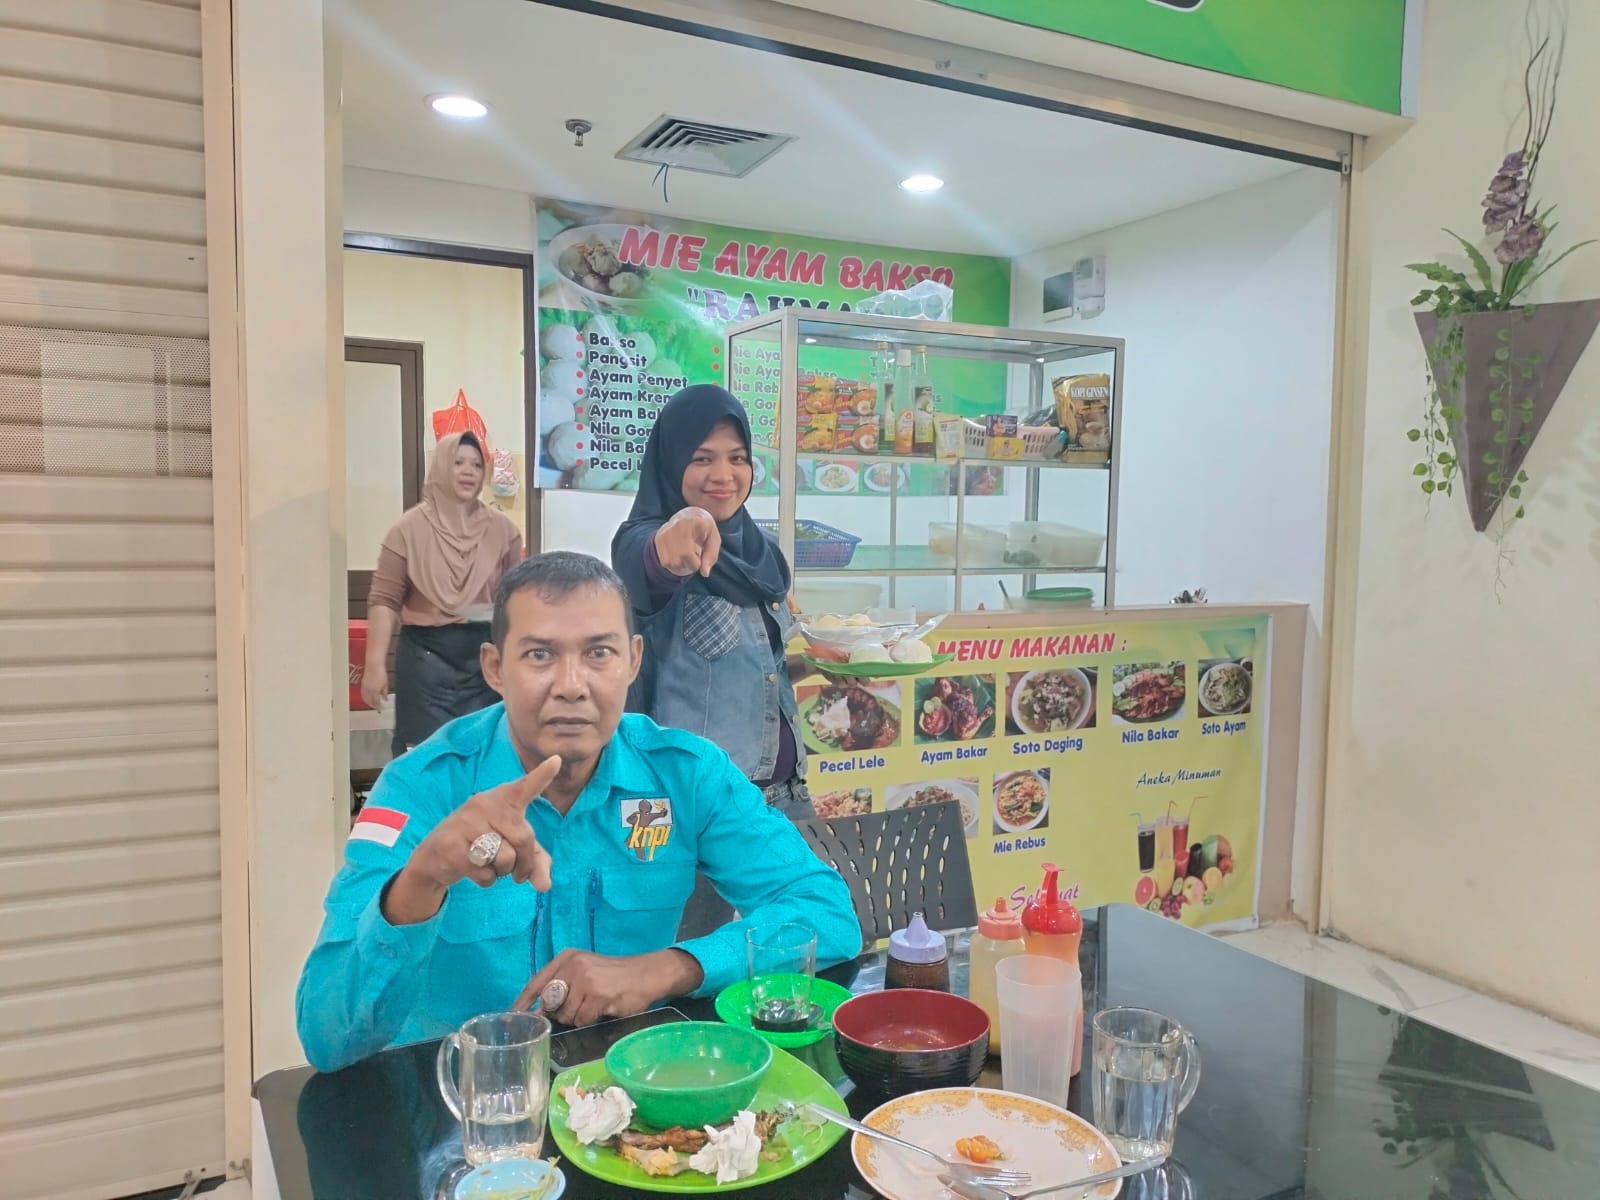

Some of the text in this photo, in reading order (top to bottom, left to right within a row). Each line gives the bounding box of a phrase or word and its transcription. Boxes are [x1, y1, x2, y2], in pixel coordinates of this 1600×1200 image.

[618, 226, 954, 292] MIE AYAM BAKSO
[589, 332, 636, 349] Baso
[589, 350, 647, 369] Pangsit
[754, 348, 781, 362] Aya
[590, 369, 688, 390] Ayam Penyet
[754, 365, 781, 379] Aya
[590, 387, 633, 403] Ayam
[754, 382, 779, 394] Reb
[590, 404, 633, 420] Ayam
[590, 422, 620, 436] Nila
[590, 440, 620, 453] Nila
[590, 457, 632, 471] Pecel
[937, 638, 1004, 662] MENU
[1009, 632, 1116, 658] MAKANAN
[1122, 727, 1179, 743] Nila Bakar
[1201, 720, 1246, 735] Soto Ayam
[1012, 736, 1083, 754] Soto Daging
[921, 746, 988, 765] Ayam Bakar
[819, 755, 885, 773] Pecel Lele
[1136, 769, 1221, 789] Aneka Minuman
[993, 837, 1046, 854] Mie Rebus
